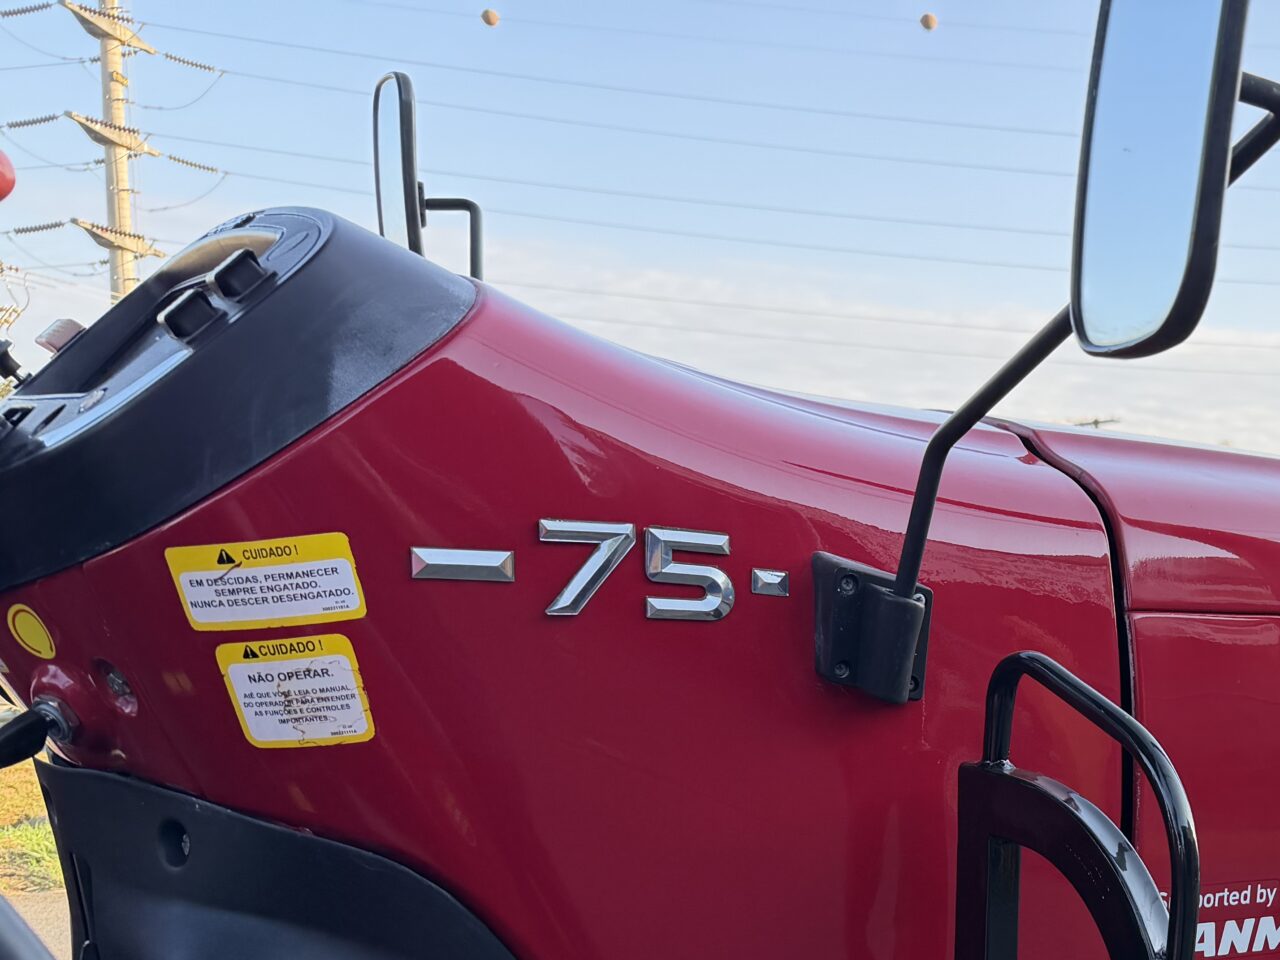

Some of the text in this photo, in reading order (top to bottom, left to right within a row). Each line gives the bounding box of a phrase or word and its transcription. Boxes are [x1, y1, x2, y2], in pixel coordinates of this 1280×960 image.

[242, 546, 292, 561] CUIDADO
[189, 567, 339, 588] EM DESCIDAS, PERMANECER
[214, 581, 321, 597] SEMPRE ENGATADO.
[190, 587, 354, 610] NUNCA DESCER DESENGATADO.
[258, 640, 316, 656] CUIDADO
[247, 667, 334, 684] NÃO OPERAR.
[256, 691, 270, 699] QUE
[318, 685, 350, 694] MANUAL
[316, 693, 357, 703] ENTENDER
[306, 703, 351, 714] CONTROLES
[1256, 883, 1277, 908] by
